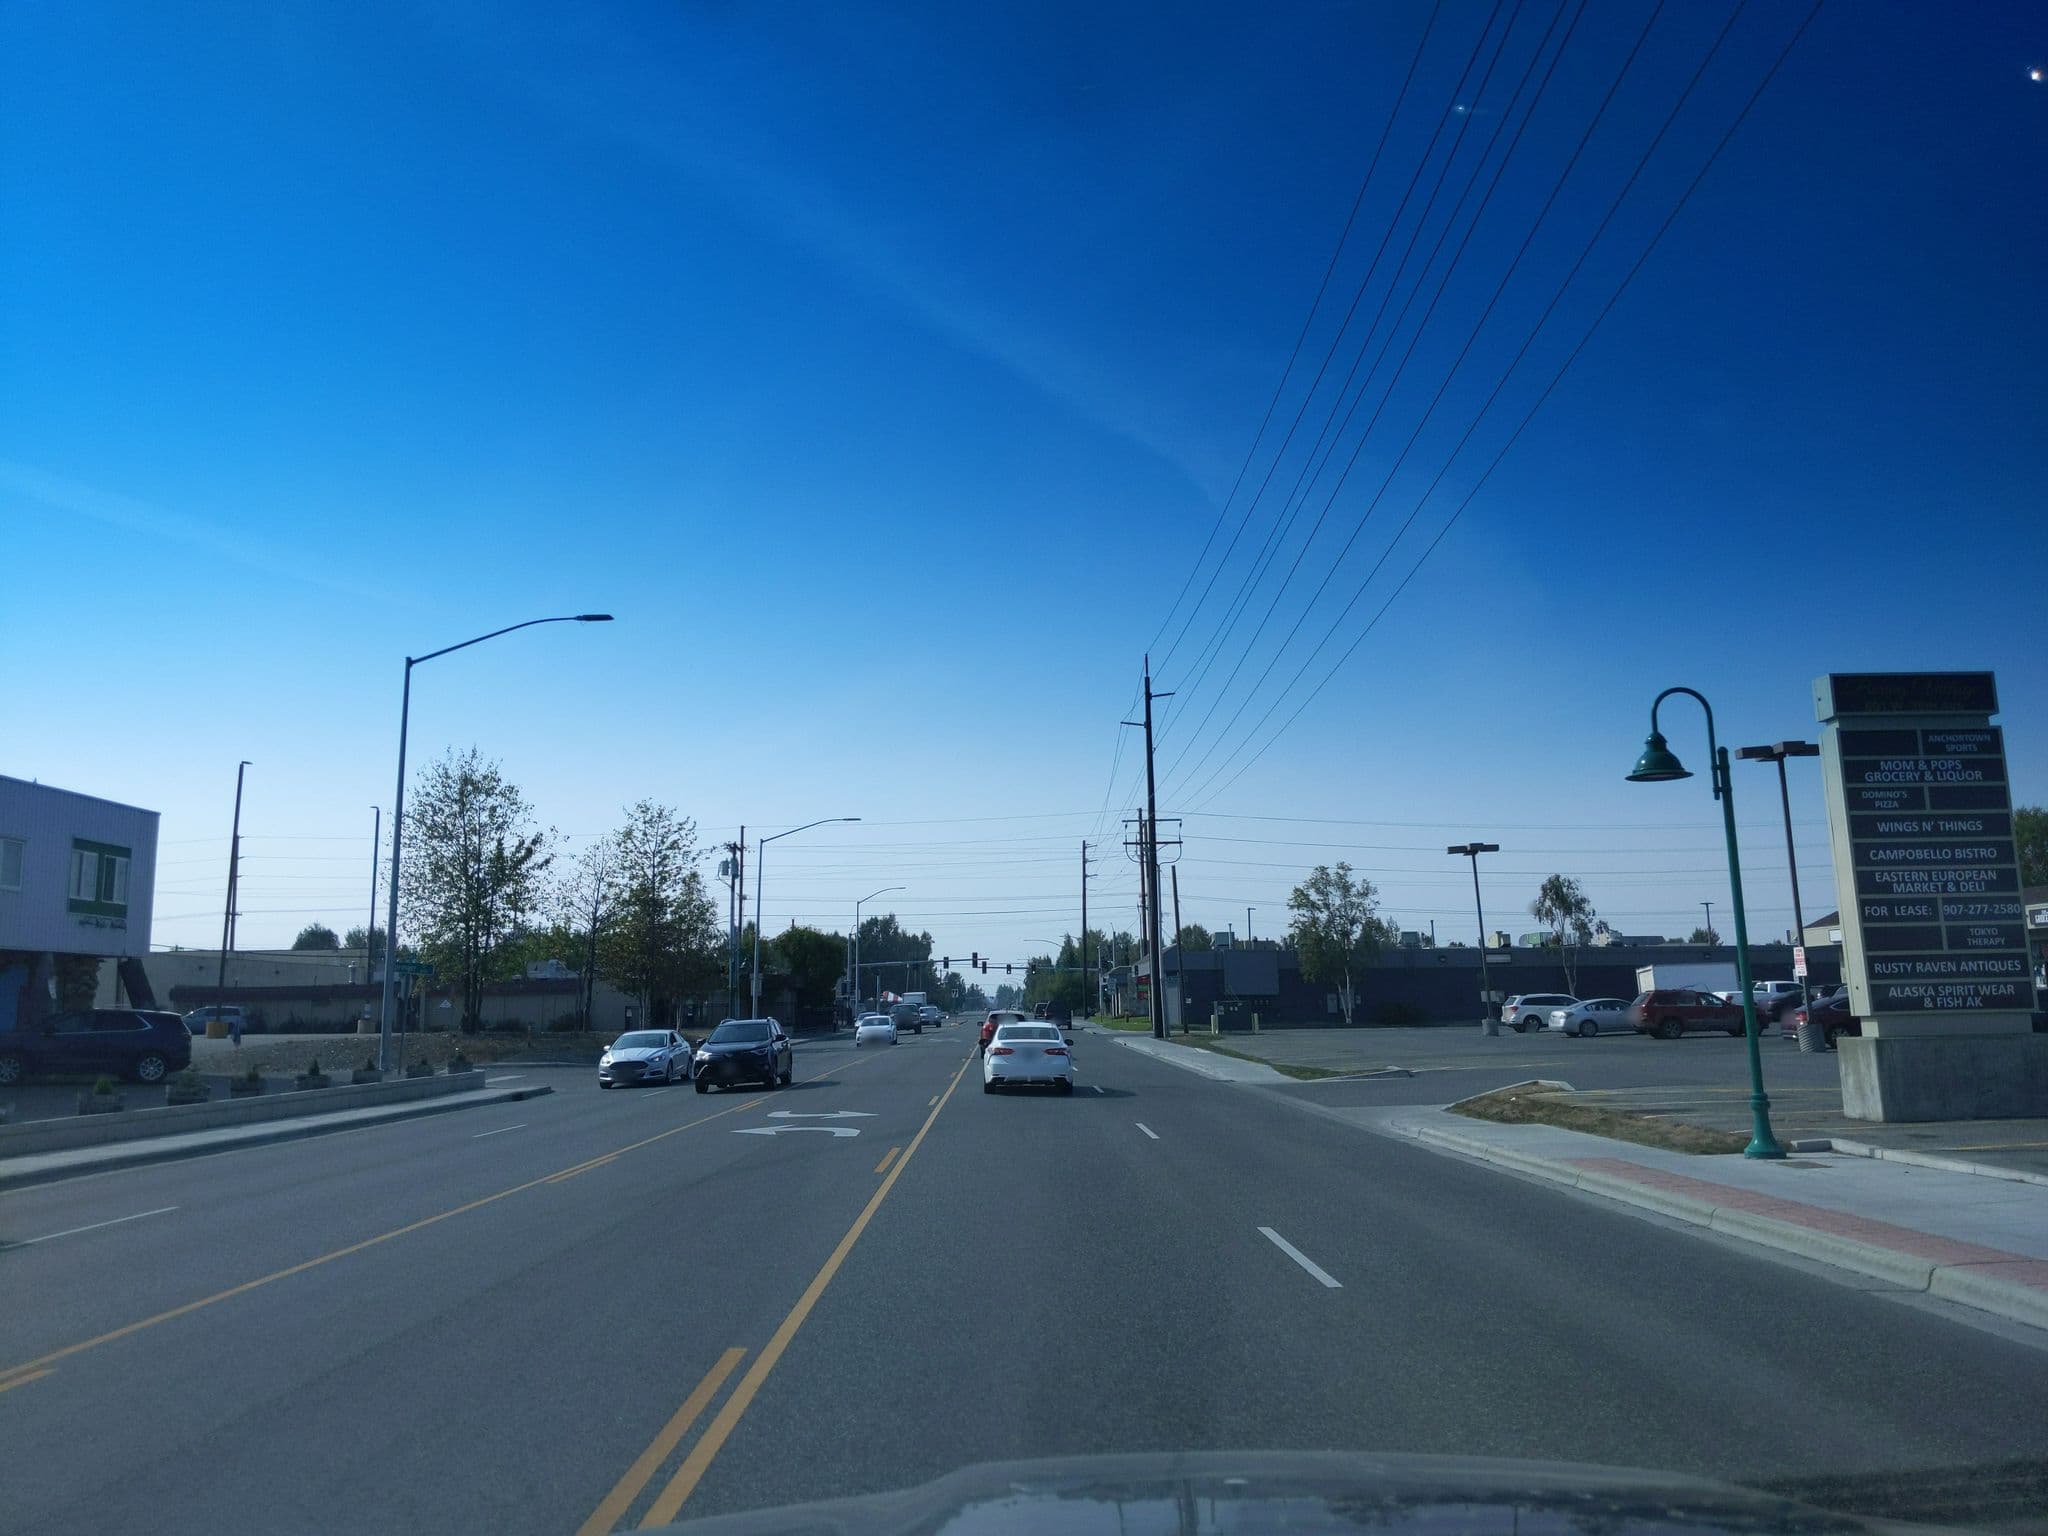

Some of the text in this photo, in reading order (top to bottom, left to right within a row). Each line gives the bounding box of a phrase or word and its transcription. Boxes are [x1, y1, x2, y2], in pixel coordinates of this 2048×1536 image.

[1945, 743, 1977, 752] SPORTS
[1880, 759, 1962, 771] MOM & POPS
[1865, 770, 1983, 783] GROCERY & LIQUOR
[1875, 800, 1899, 809] PIZZA
[1877, 820, 1983, 832] WINGS N' THINGS
[1869, 848, 1997, 861] CAMPOBELLO BISTRO
[1875, 870, 1997, 882] EASTERN EUROPEAN
[1893, 881, 1985, 893] MARKET & DELI
[1865, 905, 1932, 917] FOR LEASE:
[1943, 903, 2021, 915] 907-277-2580
[1969, 927, 1998, 936] TOKYO
[1966, 937, 2005, 946] THERAPY
[1874, 960, 2021, 974] RUSTY RAVEN ANTIQUES
[1888, 984, 2016, 998] ALASKA SPIRIT WEAR
[1923, 996, 1983, 1008] & FISH AK
